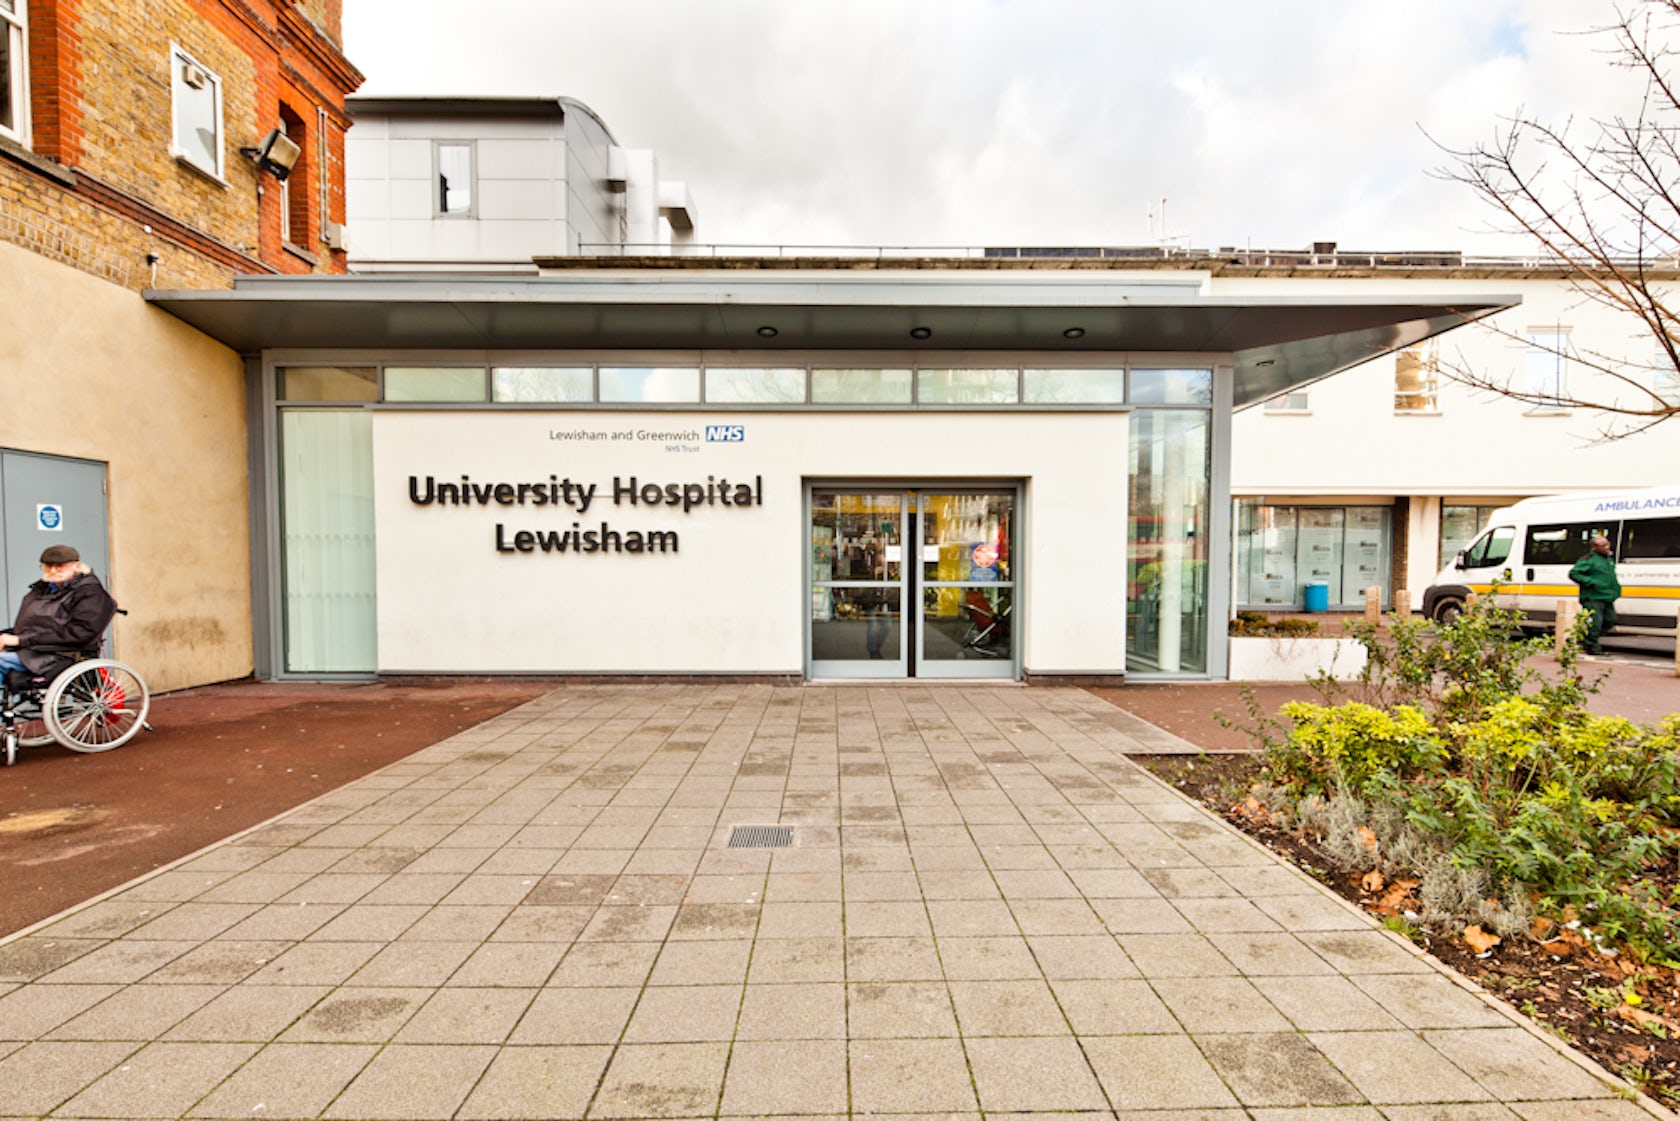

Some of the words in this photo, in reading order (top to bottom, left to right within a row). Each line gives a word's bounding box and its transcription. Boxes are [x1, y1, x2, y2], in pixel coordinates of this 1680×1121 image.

[549, 430, 608, 441] Lewisham
[611, 430, 634, 441] and
[636, 430, 700, 441] Greenwich
[706, 426, 744, 442] NHS
[665, 445, 681, 453] NHS
[682, 445, 700, 453] Trust
[409, 475, 597, 513] University
[612, 475, 763, 513] Hospital
[1594, 497, 1680, 512] AMBULANCE
[495, 522, 679, 553] Lewisham
